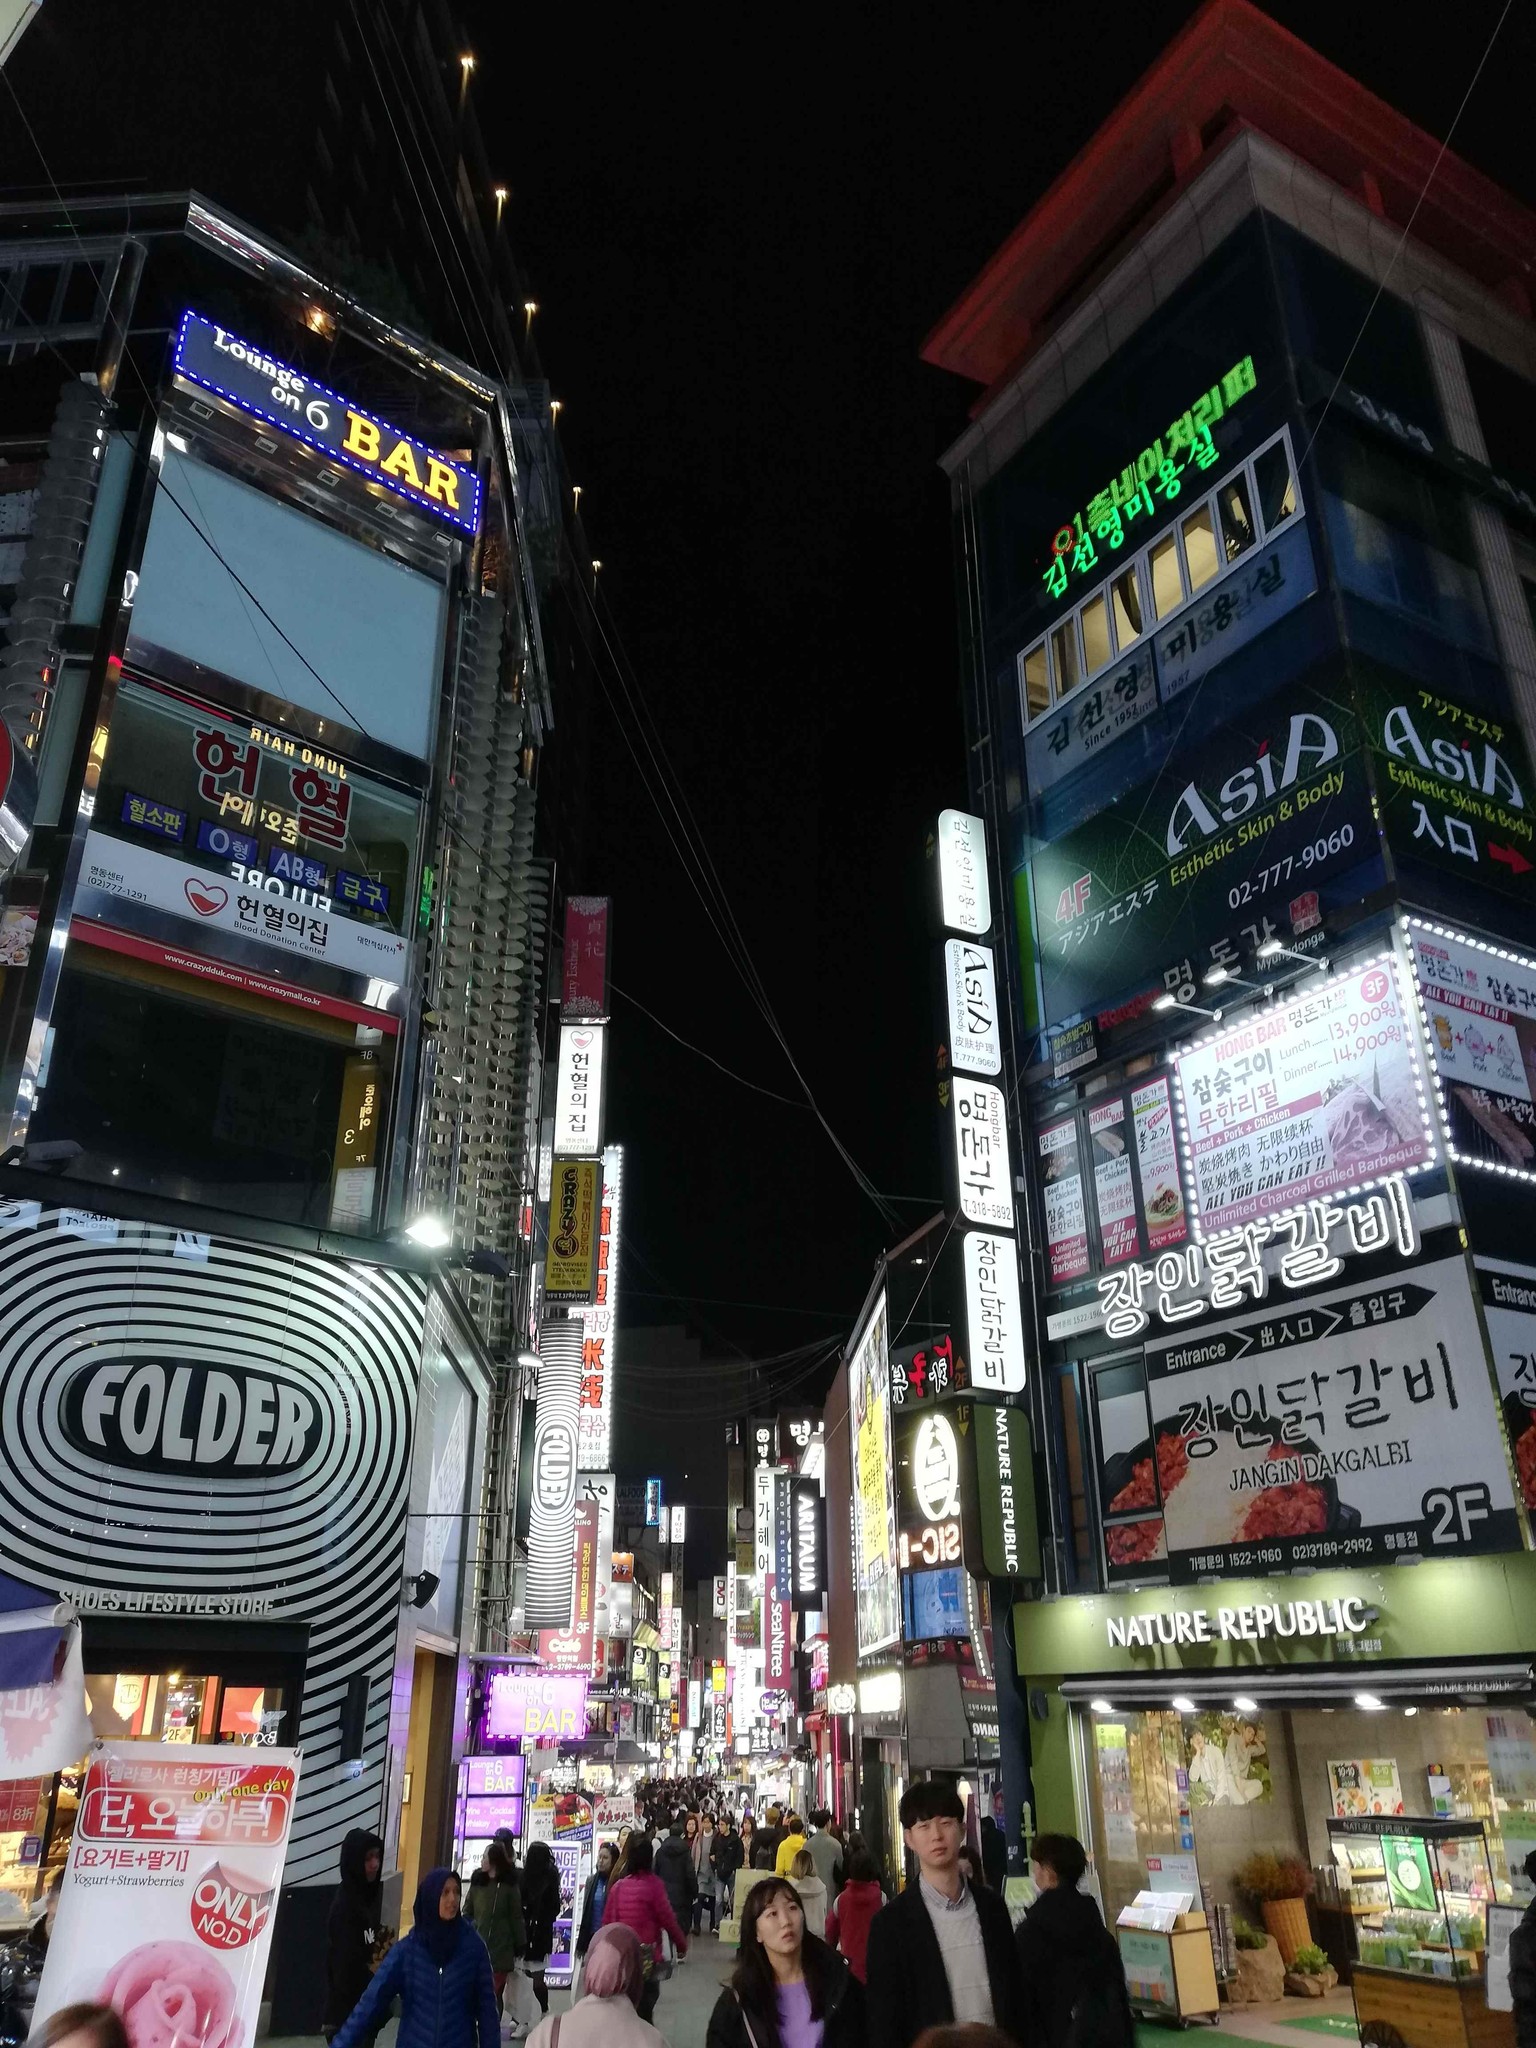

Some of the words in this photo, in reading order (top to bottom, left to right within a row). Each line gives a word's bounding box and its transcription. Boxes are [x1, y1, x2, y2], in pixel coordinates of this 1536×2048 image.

[213, 327, 305, 393] Lounge
[271, 385, 301, 411] on
[305, 400, 330, 430] 6
[342, 409, 459, 510] BAR
[1042, 423, 1220, 598] 김선영미용실
[1084, 726, 1111, 750] Since
[1115, 706, 1139, 727] 1957
[196, 731, 351, 849] 헌혈
[1388, 761, 1449, 801] Esthetic
[1450, 789, 1481, 817] Skin
[1485, 809, 1495, 823] &
[1499, 809, 1533, 842] Body
[129, 799, 183, 836] 혈소판
[1170, 839, 1234, 887] Esthetic
[1238, 815, 1275, 847] Skin
[1279, 802, 1294, 822] &
[1296, 770, 1345, 812] Body
[1412, 800, 1479, 863] 入口
[208, 828, 249, 861] O형
[90, 864, 124, 884] 명동센터
[273, 852, 322, 888] AB형
[1228, 823, 1354, 909] 02-777-9060
[87, 876, 148, 902] (02)777-1291
[341, 876, 383, 908] 급구
[1056, 872, 1092, 925] 4F
[236, 895, 329, 947] 헌혈의집
[1059, 879, 1159, 955] アジアエステ
[233, 920, 257, 935] Blood
[260, 928, 297, 947] Donation
[298, 939, 326, 956] Center
[953, 943, 963, 979] Esthetic
[164, 953, 243, 984] www.crazydduk.com
[249, 978, 322, 1007] www.crazymall.co.kr
[1363, 975, 1385, 997] 3F
[1425, 985, 1441, 1000] ALL
[1443, 990, 1461, 1006] YOU
[1463, 996, 1482, 1013] CAN
[1484, 1004, 1500, 1019] EAT
[957, 1008, 966, 1033] Body
[1214, 1032, 1254, 1063] HONG
[1257, 1018, 1287, 1047] BAR
[1288, 997, 1332, 1029] 명돈가
[1280, 1038, 1311, 1061] Lunch
[1329, 1002, 1396, 1041] 13,900원
[954, 1052, 997, 1069] T.777.9060
[1284, 1060, 1318, 1083] Dinner
[1334, 1025, 1402, 1065] 14,900원
[938, 1080, 950, 1096] 3F
[1191, 1047, 1274, 1105] 참숯구이
[990, 1091, 1000, 1149] Hongbar
[1089, 1107, 1112, 1126] HONG
[1111, 1111, 1125, 1123] BAR
[1197, 1078, 1280, 1135] 무한리필
[959, 1091, 995, 1197] 명돈가
[1195, 1136, 1215, 1154] Beef
[1224, 1126, 1244, 1144] Pork
[1254, 1109, 1291, 1130] Chicken
[1095, 1165, 1108, 1177] Beef
[1115, 1158, 1129, 1167] Pork
[1259, 1137, 1325, 1172] かわり自由
[1104, 1167, 1128, 1182] Chicken
[1204, 1197, 1257, 1229] Unlimited
[1259, 1182, 1311, 1213] Charcoal
[1314, 1166, 1356, 1196] Grilled
[1357, 1143, 1422, 1179] Barbeque
[1204, 1191, 1226, 1211] ALL
[1230, 1184, 1254, 1203] YOU
[1257, 1174, 1284, 1192] CAN
[1287, 1162, 1311, 1181] EAT
[963, 1198, 1012, 1221] T.318-5892
[1055, 1238, 1081, 1254] Unlimited
[1103, 1235, 1119, 1249] YOU
[1120, 1227, 1137, 1242] CAN
[1112, 1221, 1125, 1235] ALL
[1051, 1251, 1071, 1265] Charcoal
[1071, 1246, 1088, 1258] Grilled
[1053, 1256, 1087, 1276] Barbeque
[1098, 1176, 1415, 1339] 장인닭갈비
[1110, 1244, 1124, 1258] EAT
[977, 1240, 1007, 1385] 장인닭갈비
[1349, 1292, 1406, 1326] 출입구
[1260, 1317, 1314, 1348] 出入口
[1165, 1342, 1227, 1371] Entrance
[954, 1373, 967, 1389] 2F
[81, 1364, 314, 1466] FOLDER
[957, 1407, 969, 1421] 1F
[1178, 1341, 1459, 1459] 장인닭갈비
[995, 1408, 1011, 1480] NATURE
[1303, 1440, 1413, 1480] DAKGALBI
[539, 1427, 572, 1507] FOLDER
[1000, 1485, 1019, 1574] REPUBLIC
[1424, 1485, 1491, 1546] 2F
[798, 1495, 817, 1592] ARITAUM
[1229, 1549, 1282, 1567] 1522-1960
[1292, 1538, 1373, 1560] 02)3789-2992
[59, 1589, 120, 1611] SHOES
[125, 1592, 215, 1614] LIFESTYLE
[220, 1595, 275, 1617] STORE
[576, 1622, 589, 1634] 3F
[1106, 1609, 1211, 1647] NATURE
[1220, 1597, 1368, 1641] REPUBLIC
[168, 1728, 181, 1741] 2F
[524, 1708, 576, 1733] BAR
[470, 1761, 494, 1769] Lounge
[494, 1760, 503, 1775] 6
[231, 1783, 260, 1797] one
[263, 1778, 289, 1796] day
[484, 1777, 515, 1792] BAR
[13, 1808, 34, 1822] 8折
[74, 1846, 189, 1872] [요거트+딸기]
[73, 1873, 185, 1888] Yogurt+Strawberries
[194, 1879, 271, 1931] ONLY
[197, 1914, 242, 1946] NO.D
